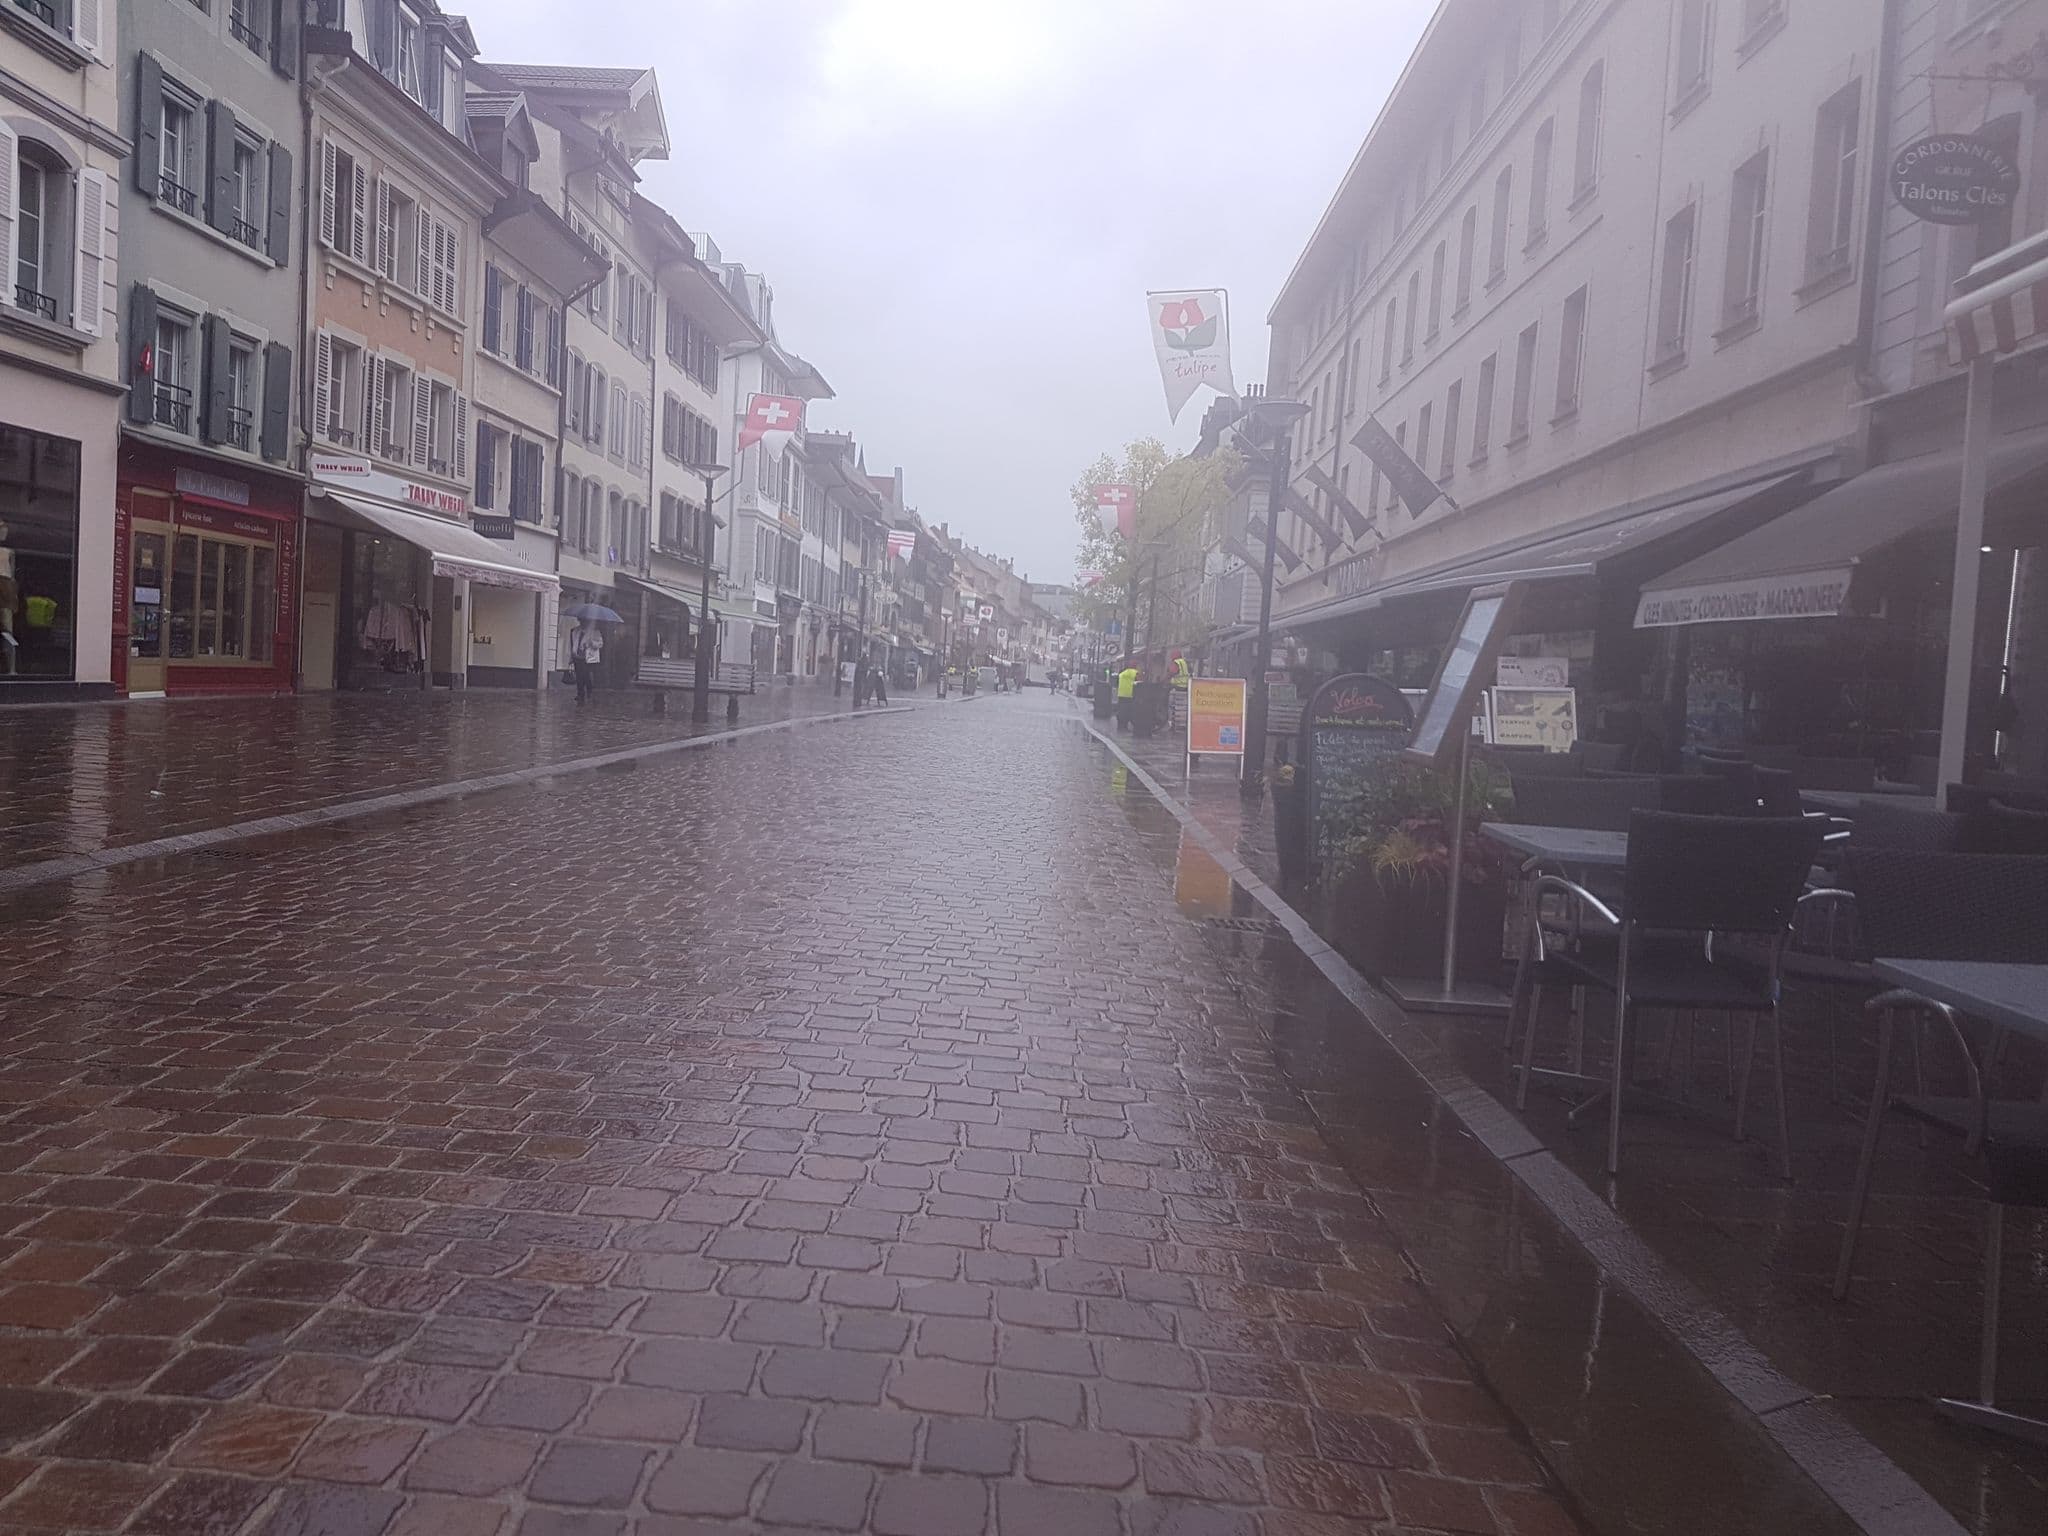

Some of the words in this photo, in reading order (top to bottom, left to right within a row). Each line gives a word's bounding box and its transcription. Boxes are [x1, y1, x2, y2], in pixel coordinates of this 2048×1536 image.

[1898, 182, 1959, 201] Talons
[1175, 361, 1216, 379] tulipe
[408, 484, 436, 505] TALLY
[475, 523, 511, 533] minelli
